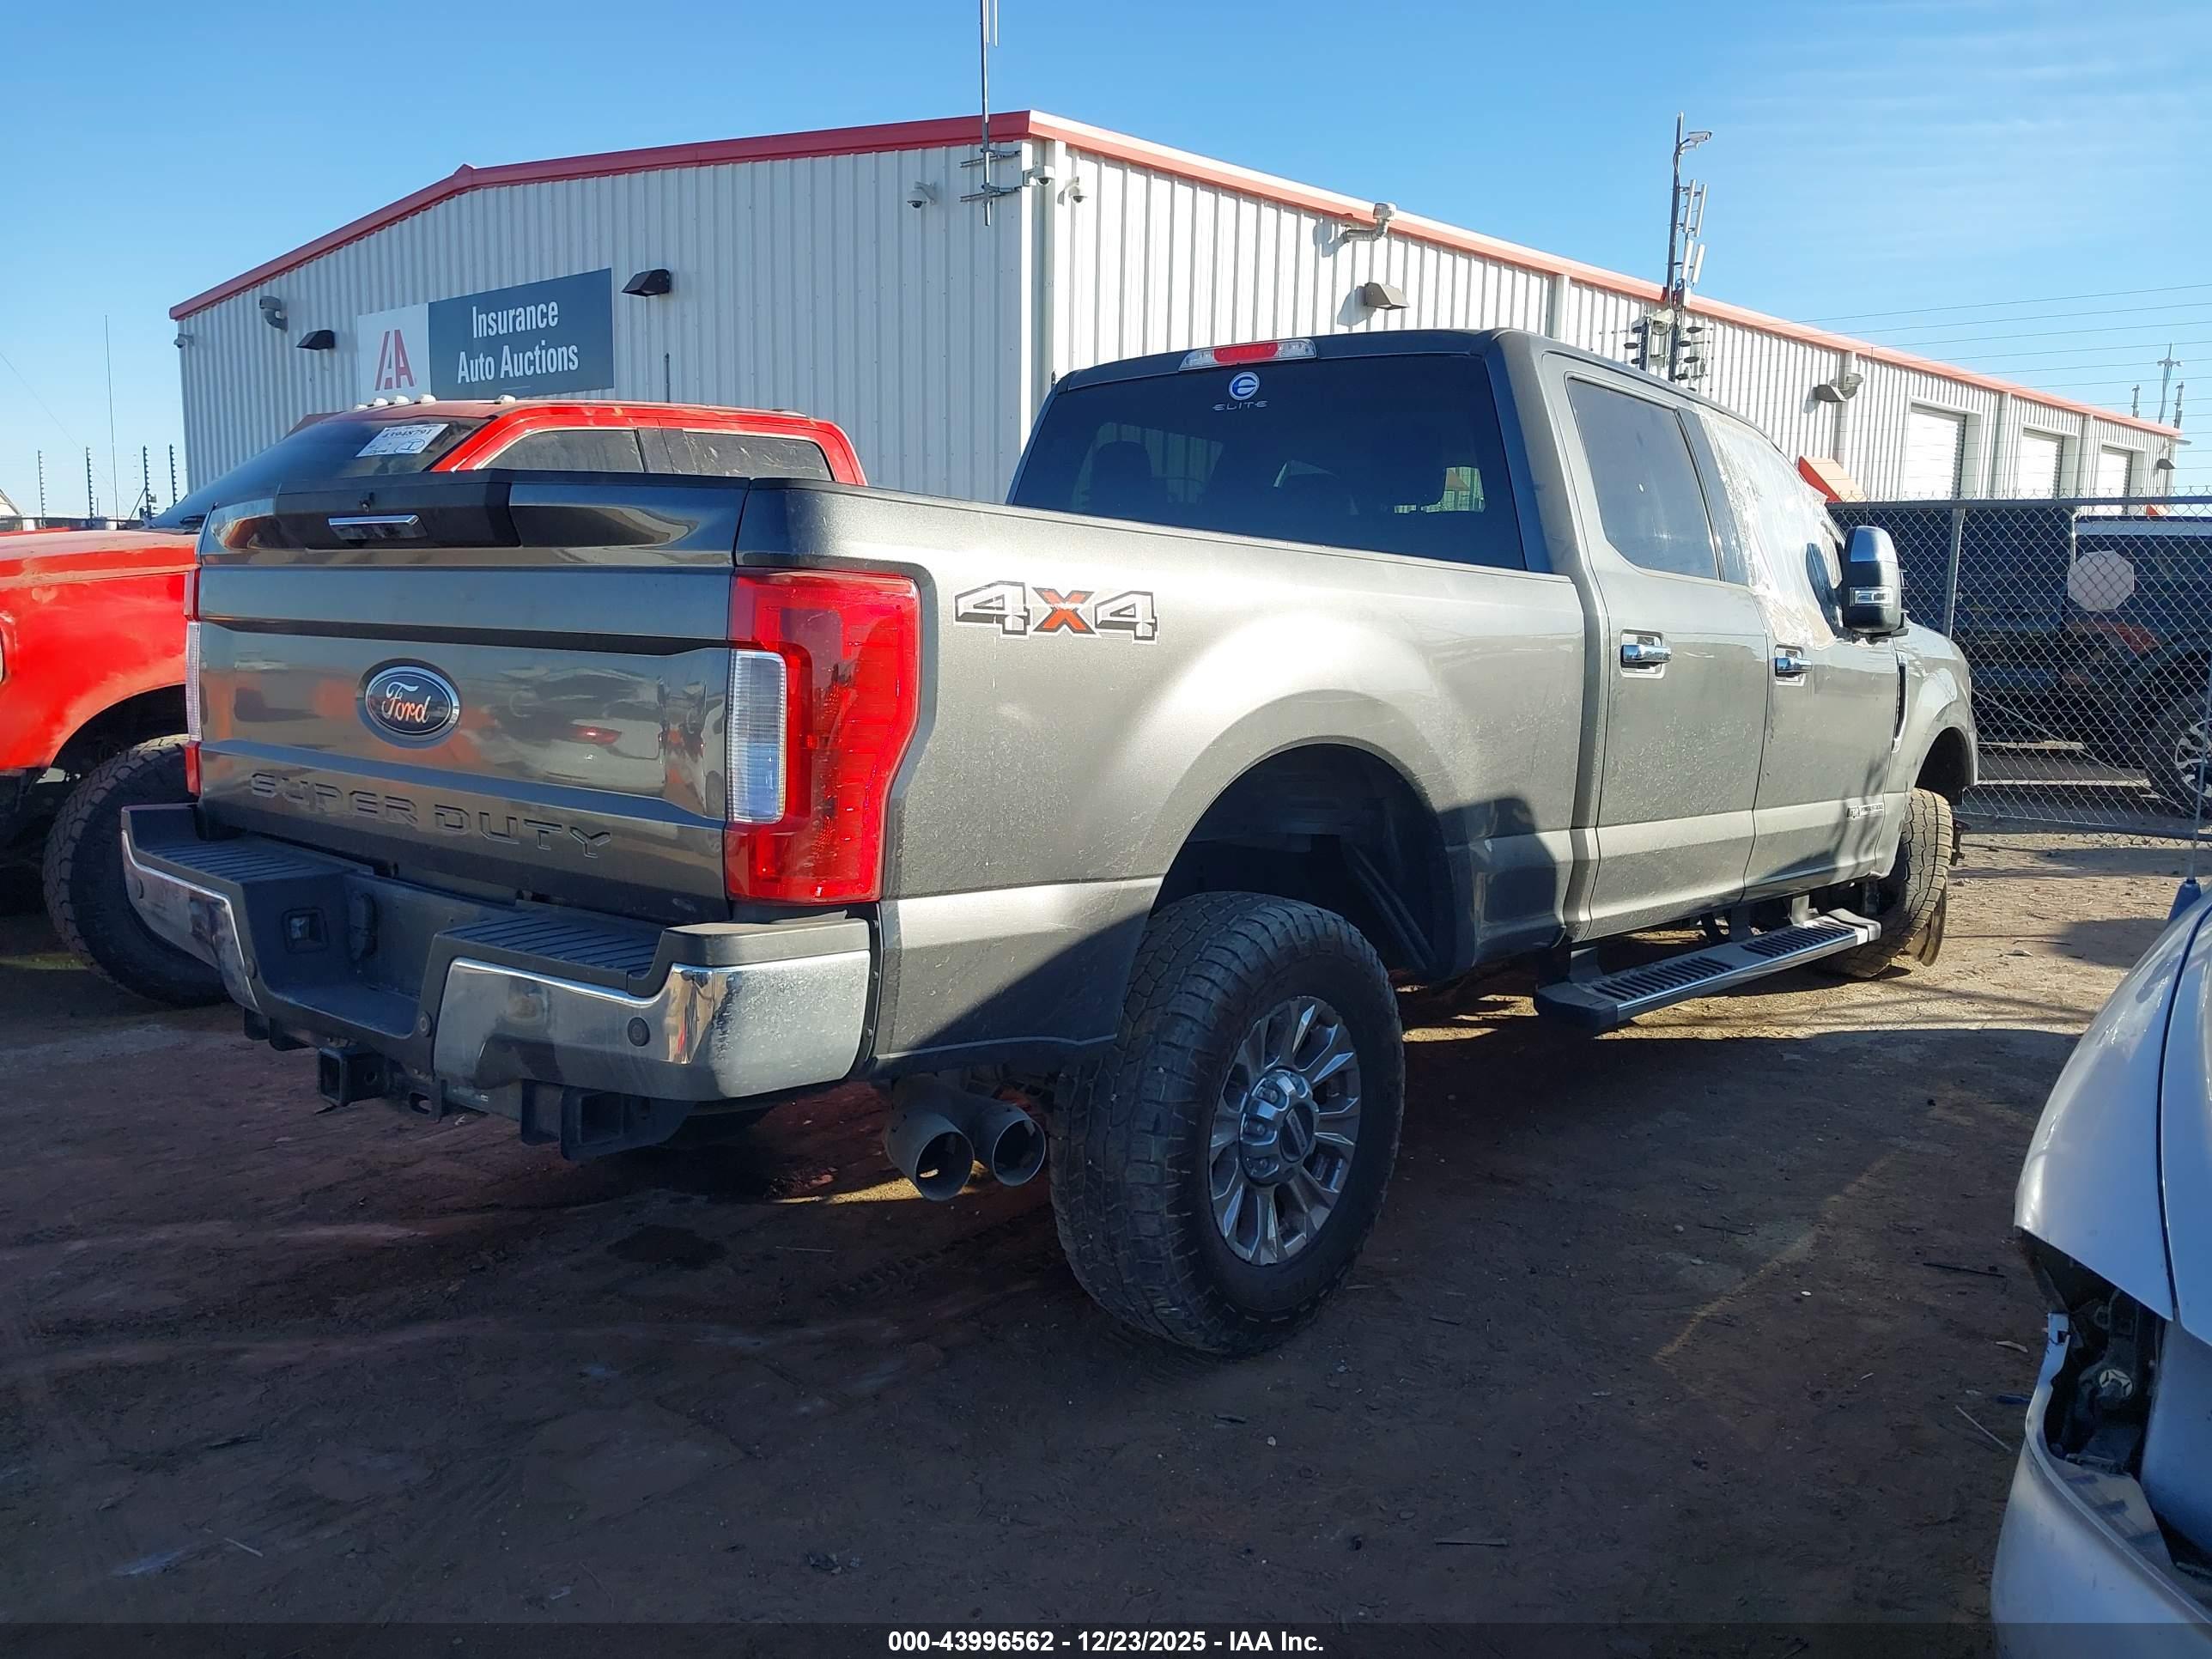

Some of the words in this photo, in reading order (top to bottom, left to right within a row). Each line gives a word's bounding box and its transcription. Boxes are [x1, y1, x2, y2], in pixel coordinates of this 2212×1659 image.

[472, 301, 559, 338] Insurance
[457, 350, 495, 385] Auto
[499, 339, 580, 379] Auctions
[1212, 400, 1269, 412] ELITE
[380, 681, 434, 725] Ford
[251, 772, 419, 826] SUPER
[434, 804, 611, 859] DUTY
